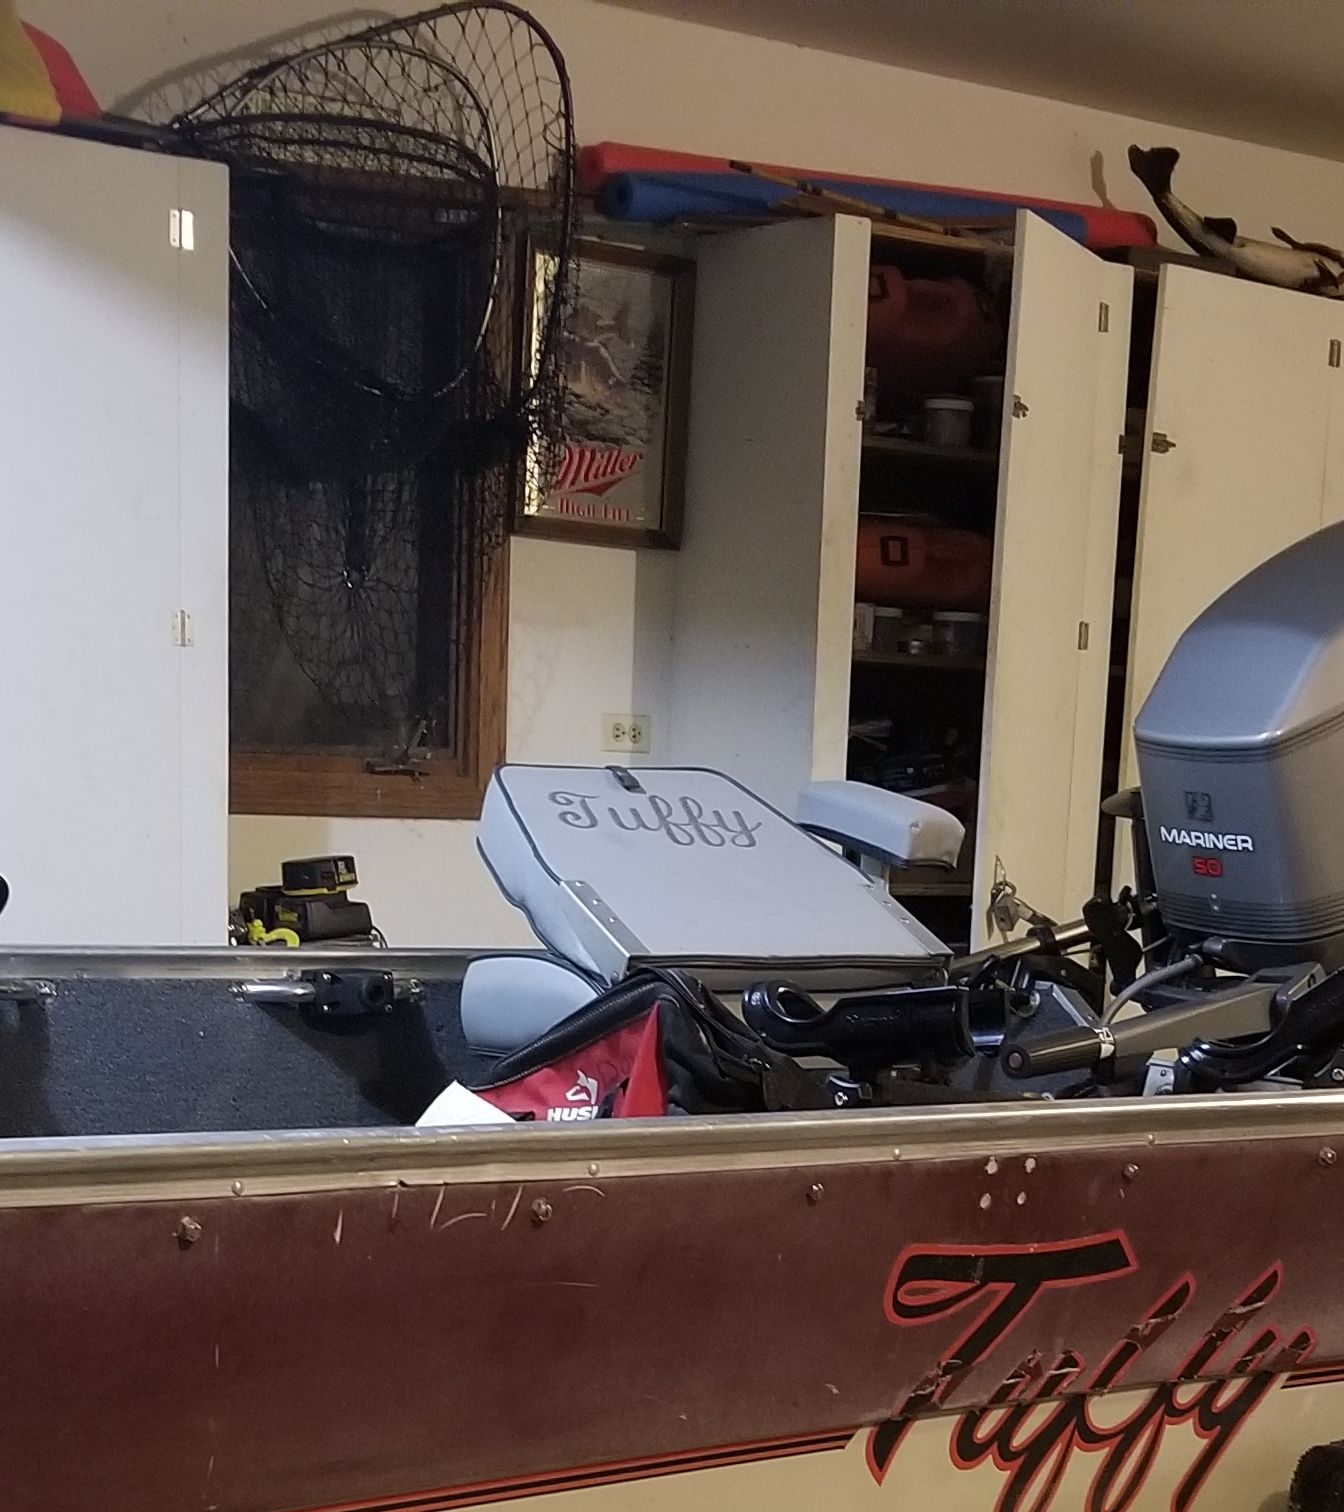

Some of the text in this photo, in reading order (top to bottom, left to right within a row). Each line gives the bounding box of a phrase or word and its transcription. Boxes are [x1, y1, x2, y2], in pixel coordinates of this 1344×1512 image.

[552, 443, 644, 492] Miller
[547, 791, 762, 848] Tuffy
[1159, 826, 1254, 851] MARINER
[1192, 856, 1223, 877] 50
